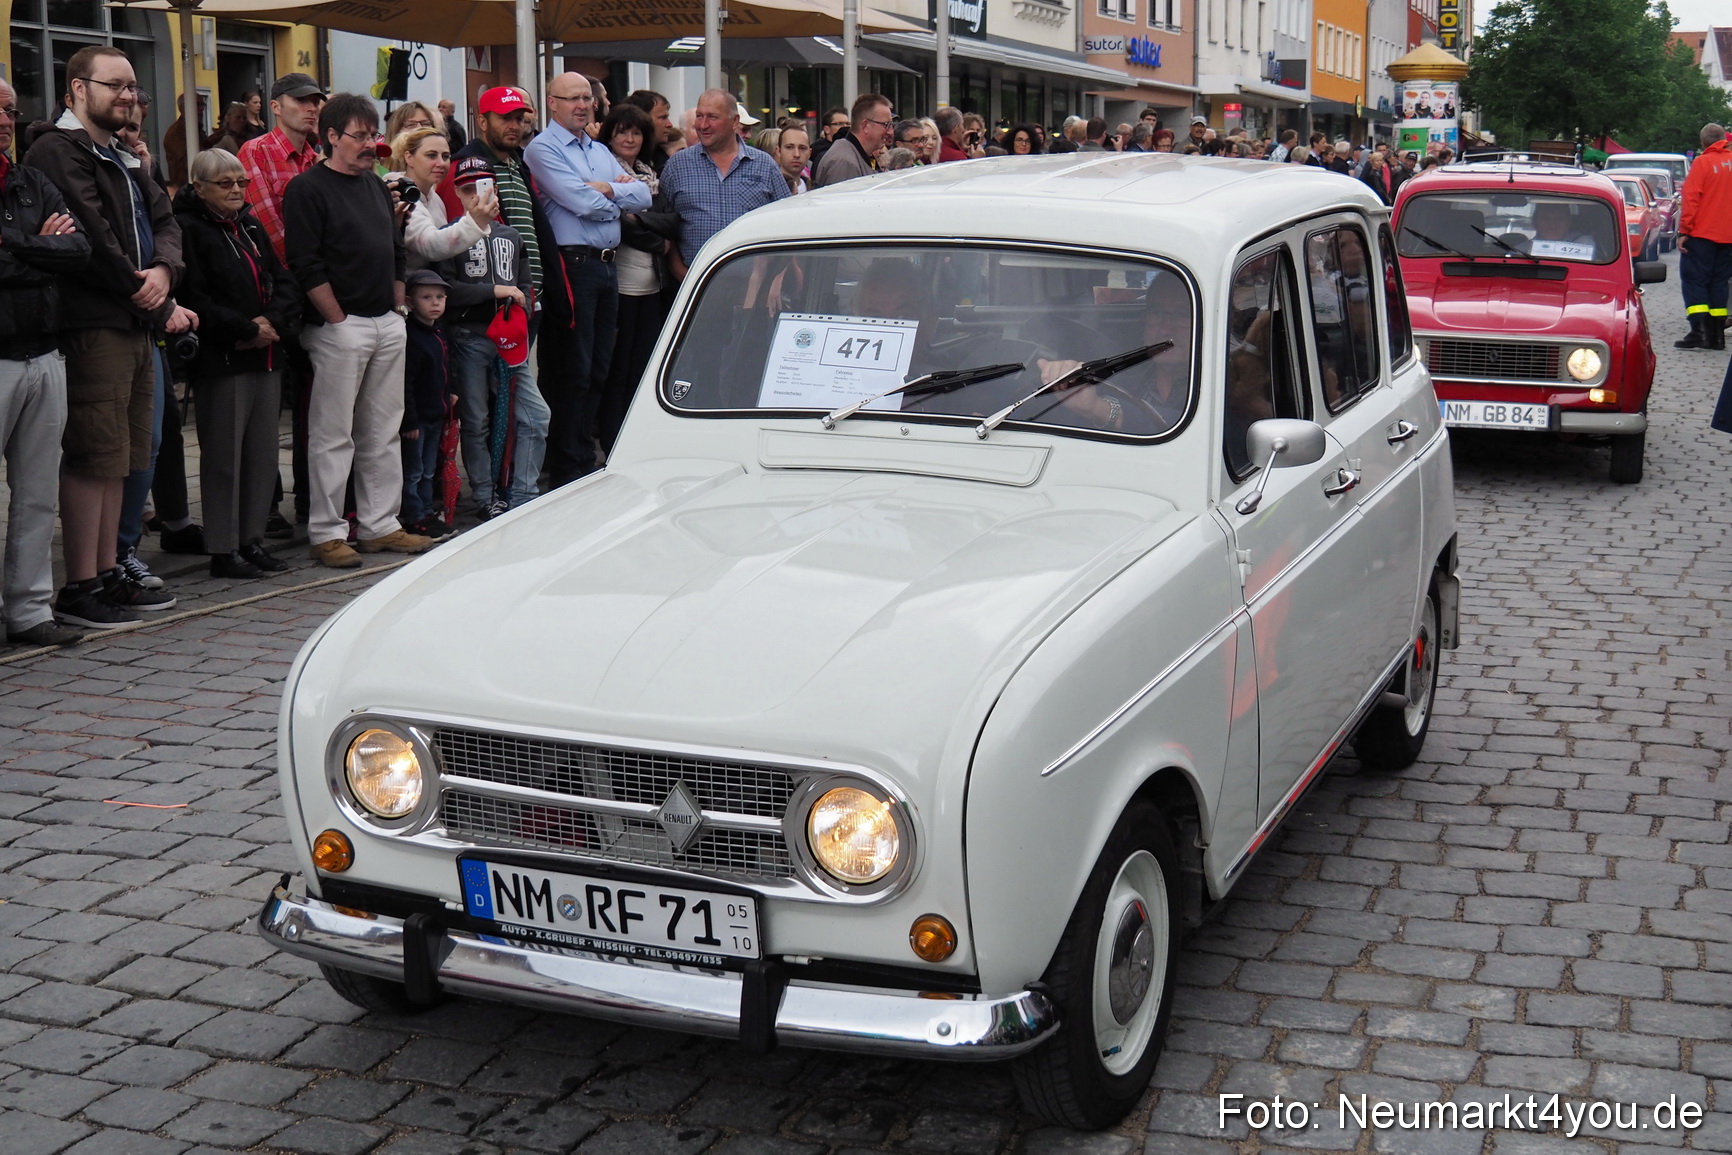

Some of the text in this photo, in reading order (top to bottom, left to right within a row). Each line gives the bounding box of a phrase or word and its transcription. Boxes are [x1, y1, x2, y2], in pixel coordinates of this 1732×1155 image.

[297, 50, 311, 67] 24
[837, 337, 884, 361] 471
[1446, 404, 1534, 424] NM GB 84
[664, 813, 692, 824] RENAULT
[475, 894, 485, 907] D
[492, 870, 721, 946] NM RF 71
[727, 903, 748, 918] 05
[501, 925, 722, 965] AUTO X.GRUBER WISSING TEL.09497/835
[733, 936, 751, 950] 10
